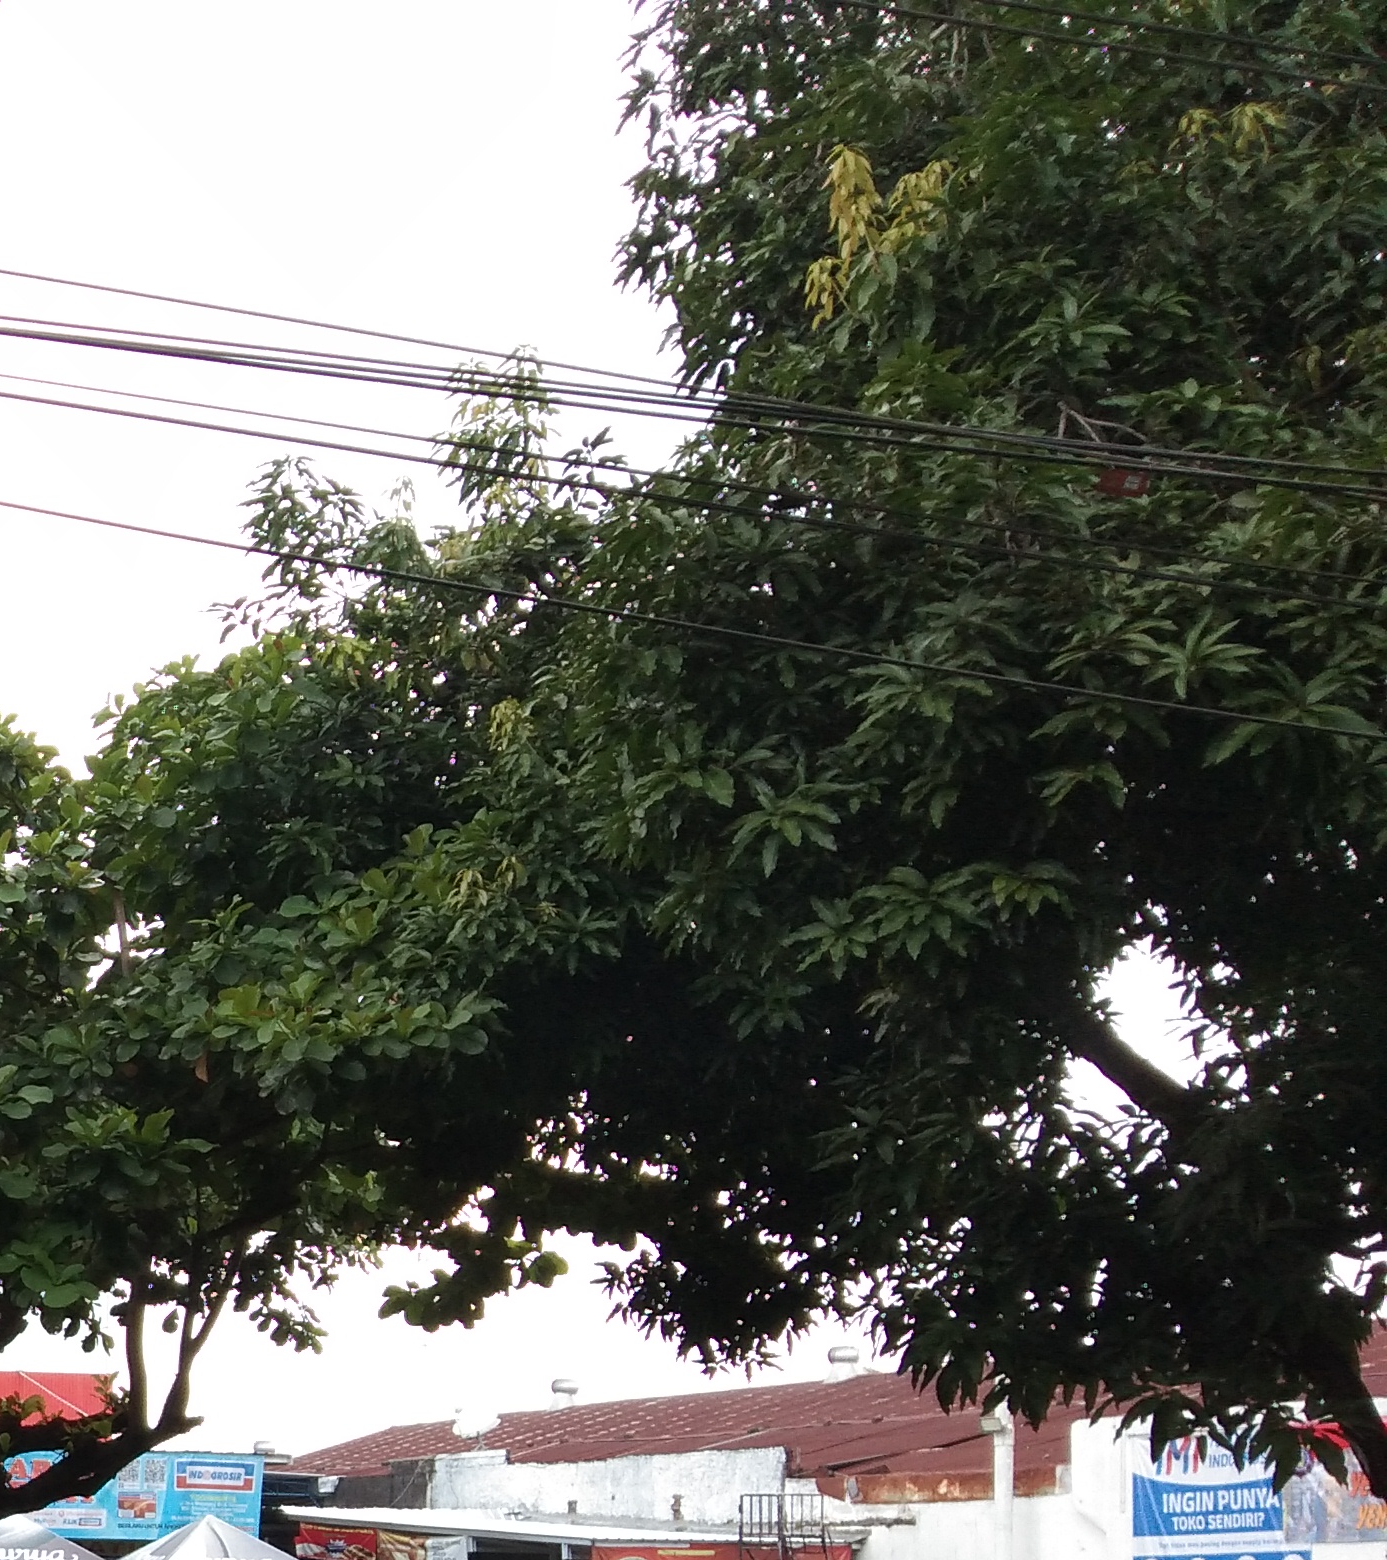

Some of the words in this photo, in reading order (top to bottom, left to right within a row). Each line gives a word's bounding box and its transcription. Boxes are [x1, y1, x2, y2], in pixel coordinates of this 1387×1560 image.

[188, 1471, 243, 1481] INDOGROSIR
[1162, 1490, 1215, 1514] INGIN
[1217, 1487, 1280, 1510] PUNYA
[1171, 1515, 1205, 1532] TOKO
[1208, 1513, 1265, 1529] SENDIRI?
